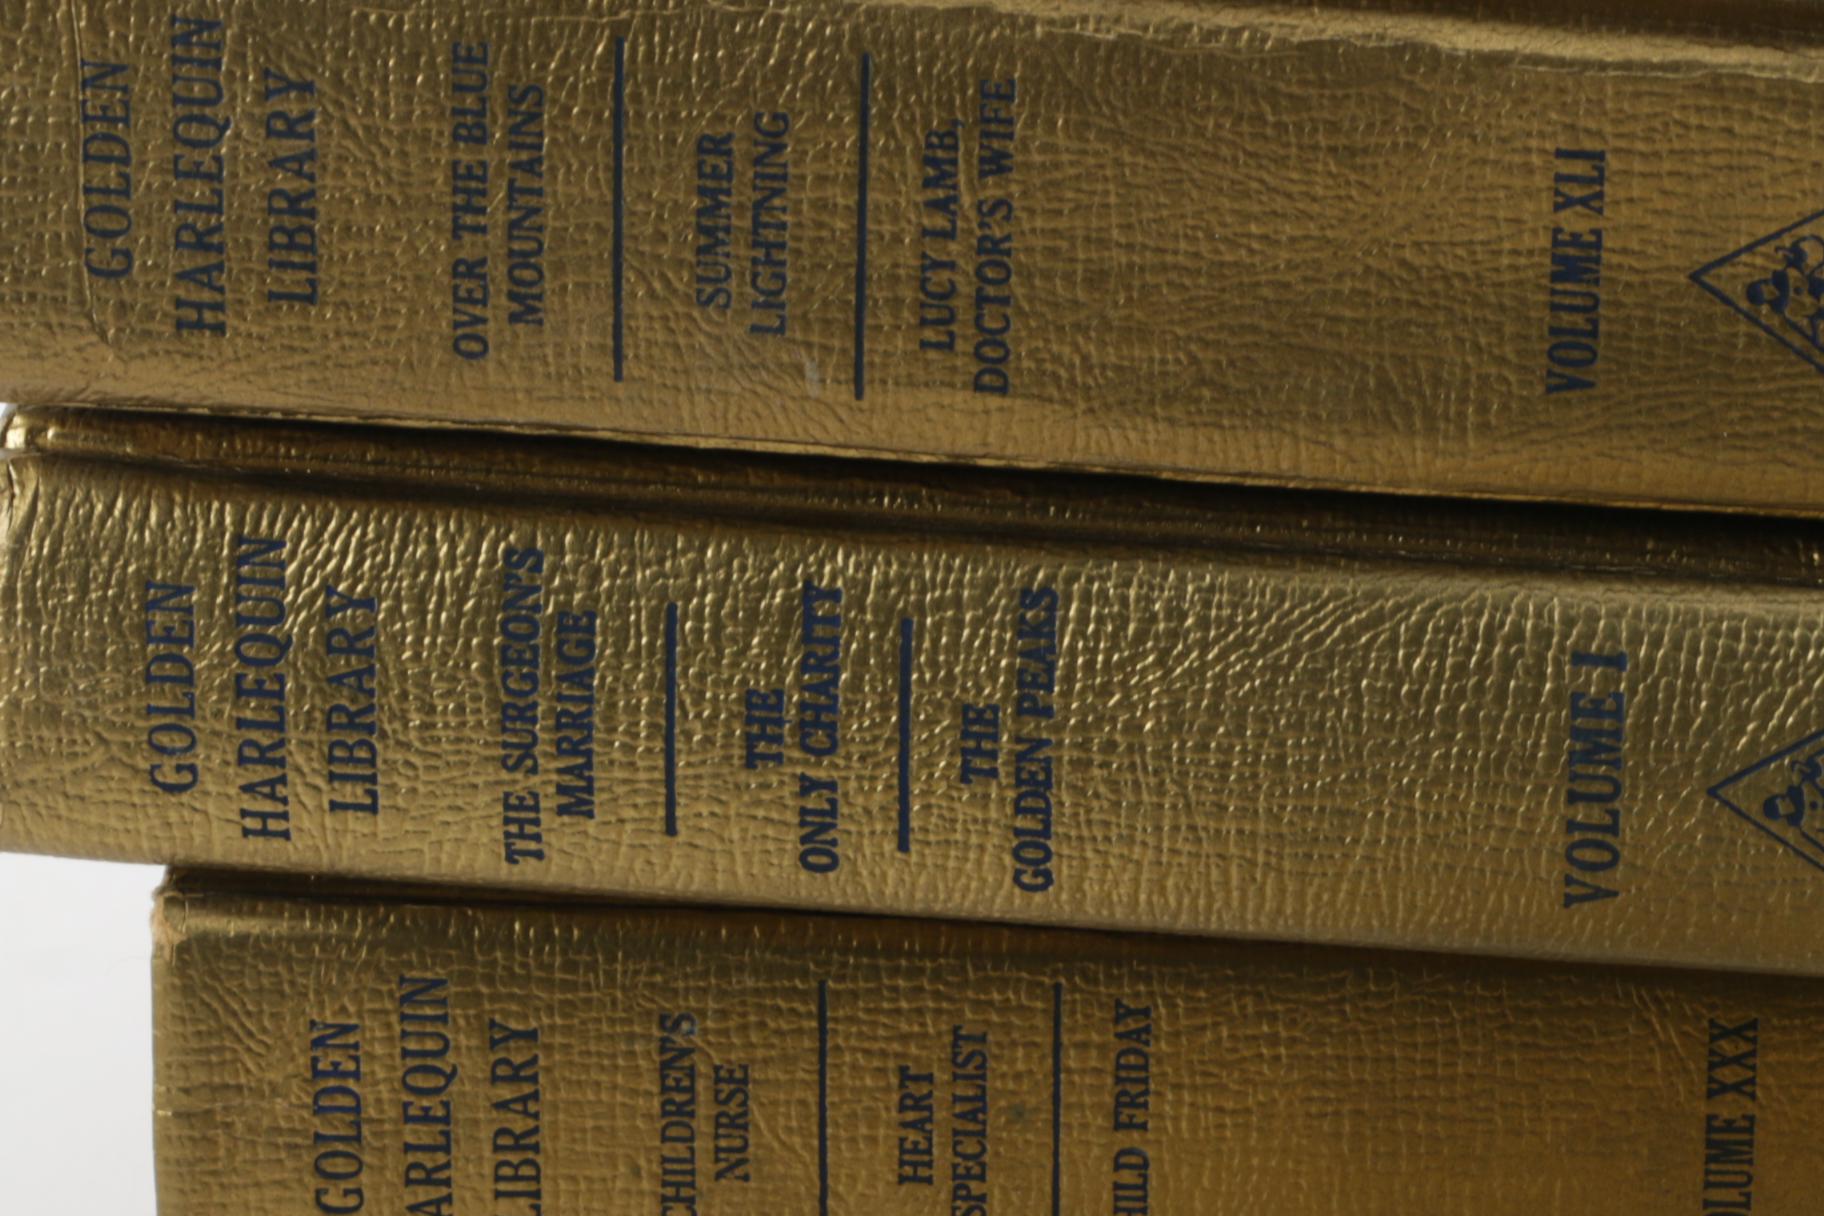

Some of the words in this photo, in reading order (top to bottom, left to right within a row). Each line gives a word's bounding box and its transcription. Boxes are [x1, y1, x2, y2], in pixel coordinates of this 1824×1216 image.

[451, 41, 491, 145] BLUE
[979, 79, 1018, 179] WIFE
[79, 58, 134, 281] GOLDEN
[171, 16, 233, 332] HARLEQUIN
[263, 69, 319, 304] LIBRARY
[452, 160, 490, 240] THE
[507, 84, 545, 325] MOUNTAINS
[696, 133, 736, 310] SUMMER
[748, 112, 791, 335] LIGHTNING
[922, 119, 964, 240] LAMB,
[1554, 149, 1606, 212] XLI
[453, 258, 490, 360] OVER
[920, 253, 958, 351] LUCY
[975, 198, 1014, 394] DOCTOR'S
[1547, 228, 1603, 393] VOLUME
[144, 581, 199, 793] GOLDEN
[235, 536, 293, 838] HARLEQUIN
[325, 585, 380, 813] LIBRARY
[501, 548, 544, 774] SURGEON'S
[555, 610, 597, 817] MARRIAGE
[800, 581, 843, 755] CHARITY
[1017, 587, 1060, 719] PEAKS
[1572, 650, 1629, 672] I
[745, 689, 789, 768] THE
[961, 704, 1000, 784] THE
[1565, 690, 1626, 905] VOLUME
[504, 792, 544, 864] THE
[800, 775, 838, 872] ONLY
[1014, 738, 1054, 891] GOLDEN
[311, 1021, 363, 1213] GOLDEN
[712, 1063, 752, 1182] NURSE
[899, 1065, 936, 1184] HEART
[1115, 1000, 1153, 1130] FRIDAY
[1707, 1018, 1761, 1099] XXX
